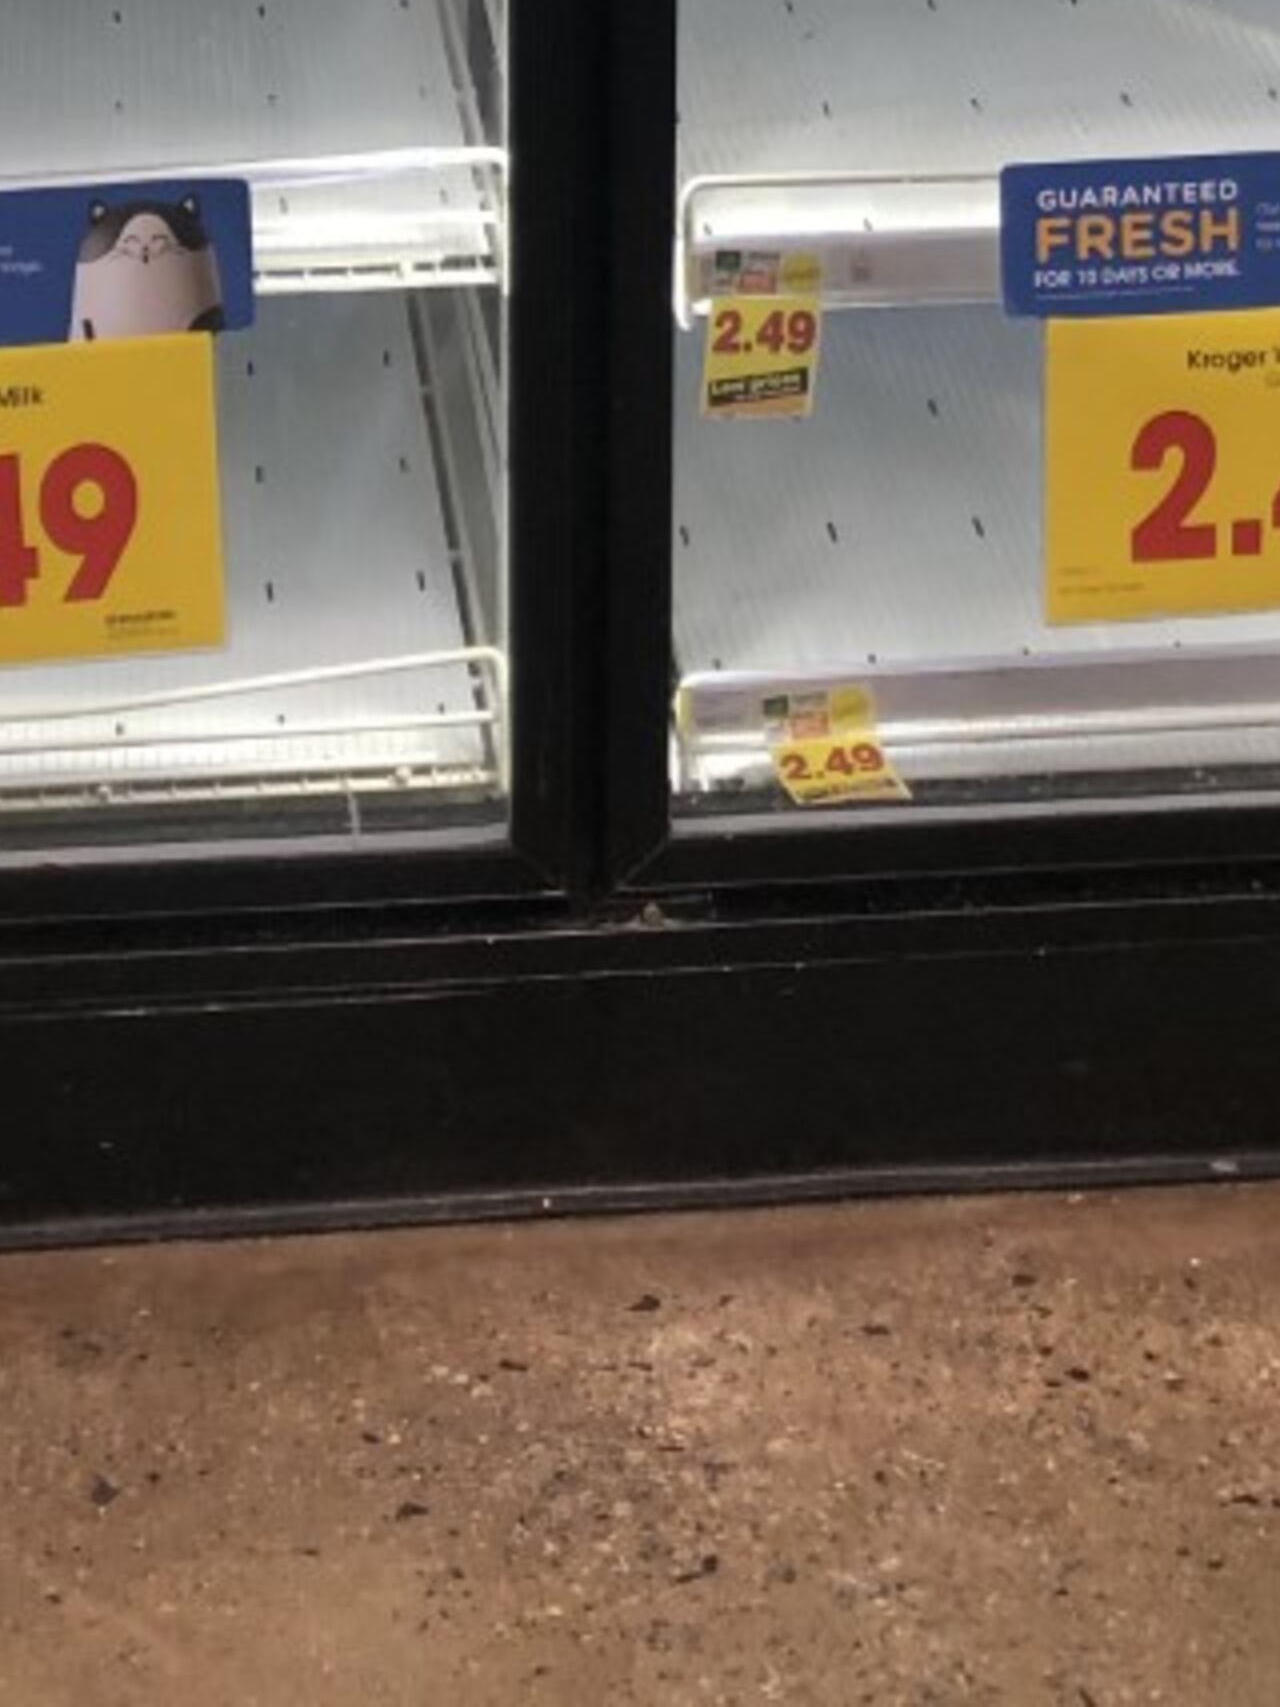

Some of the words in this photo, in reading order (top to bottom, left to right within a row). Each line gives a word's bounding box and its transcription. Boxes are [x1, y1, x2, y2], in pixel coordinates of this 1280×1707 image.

[1036, 179, 1239, 212] GUARANTEED
[1035, 206, 1240, 265] FRESH
[1033, 268, 1071, 289] FOR
[1101, 263, 1149, 286] DAYS
[1154, 263, 1182, 281] OR
[710, 308, 817, 356] 2.49
[1186, 347, 1267, 374] Kroger
[780, 742, 885, 780] 2.49
